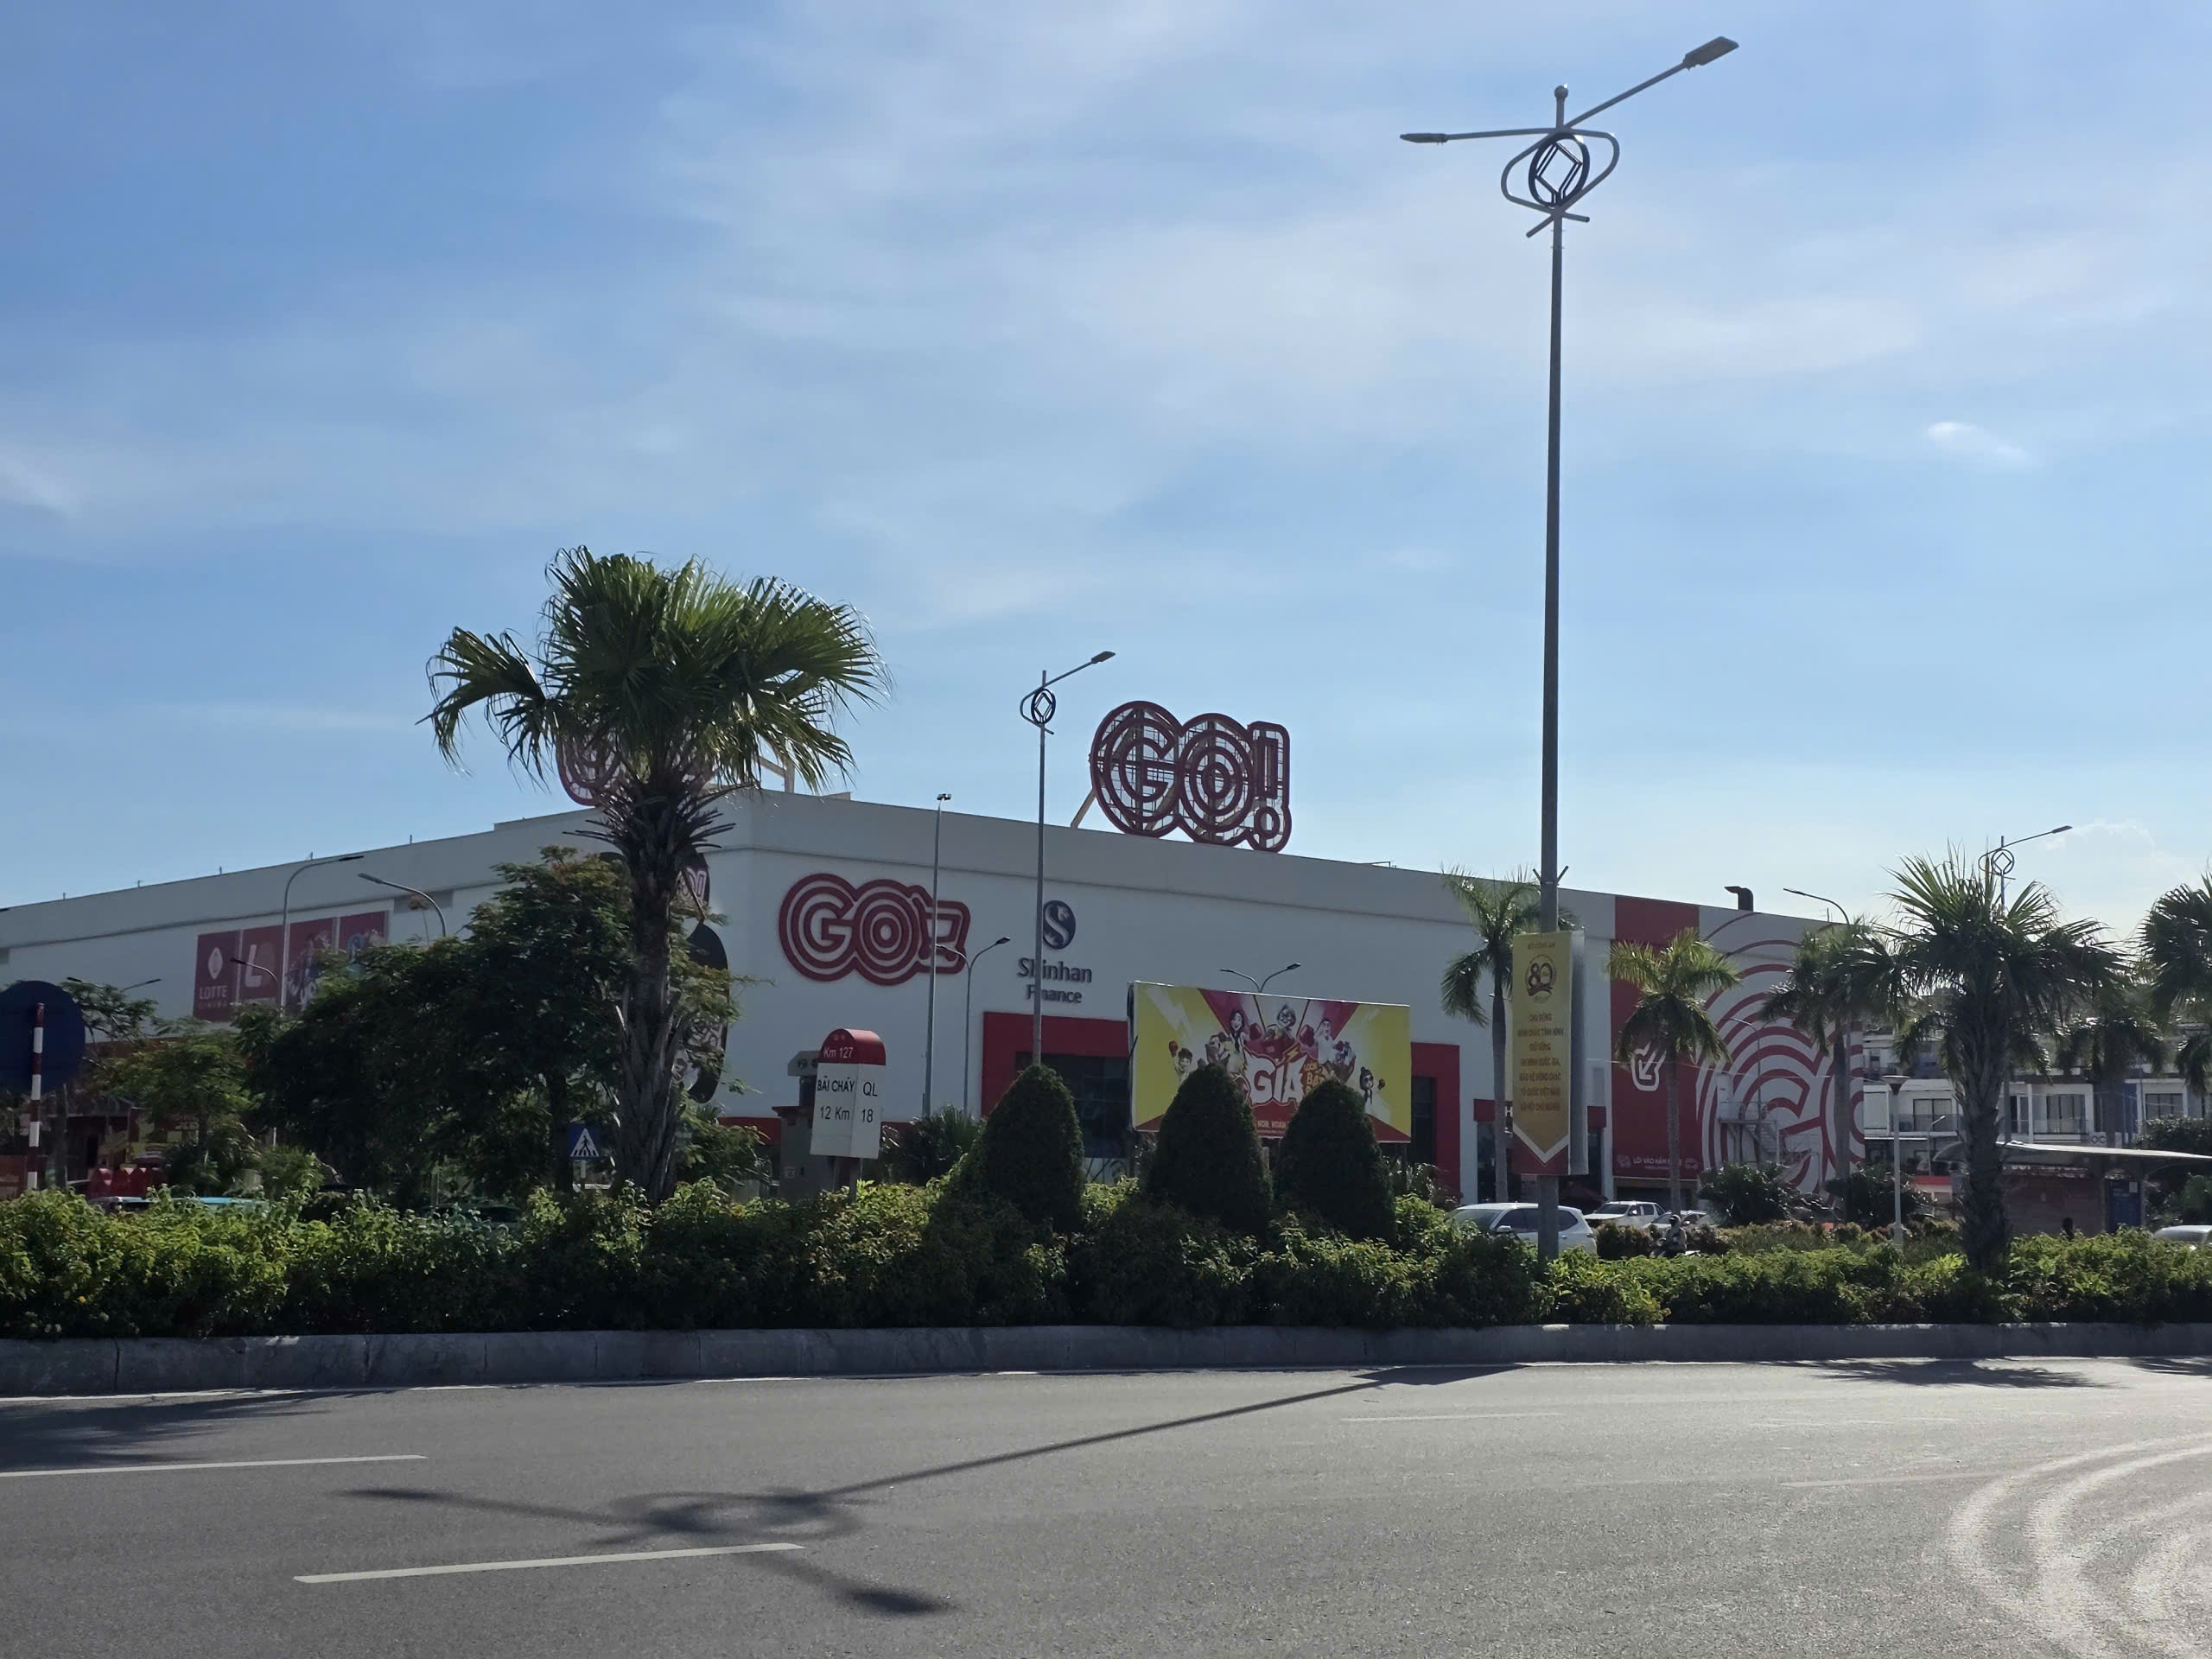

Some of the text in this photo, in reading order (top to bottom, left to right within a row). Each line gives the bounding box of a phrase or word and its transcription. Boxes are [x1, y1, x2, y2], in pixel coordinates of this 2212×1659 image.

[1090, 701, 1292, 853] GO!
[199, 985, 228, 1000] LOTTE
[1026, 984, 1082, 1003] Fnance
[823, 1046, 854, 1058] Km 127
[817, 1075, 855, 1093] BÃI CHÁY
[863, 1082, 878, 1097] QL
[820, 1106, 850, 1121] 12 Km
[861, 1109, 874, 1123] 18
